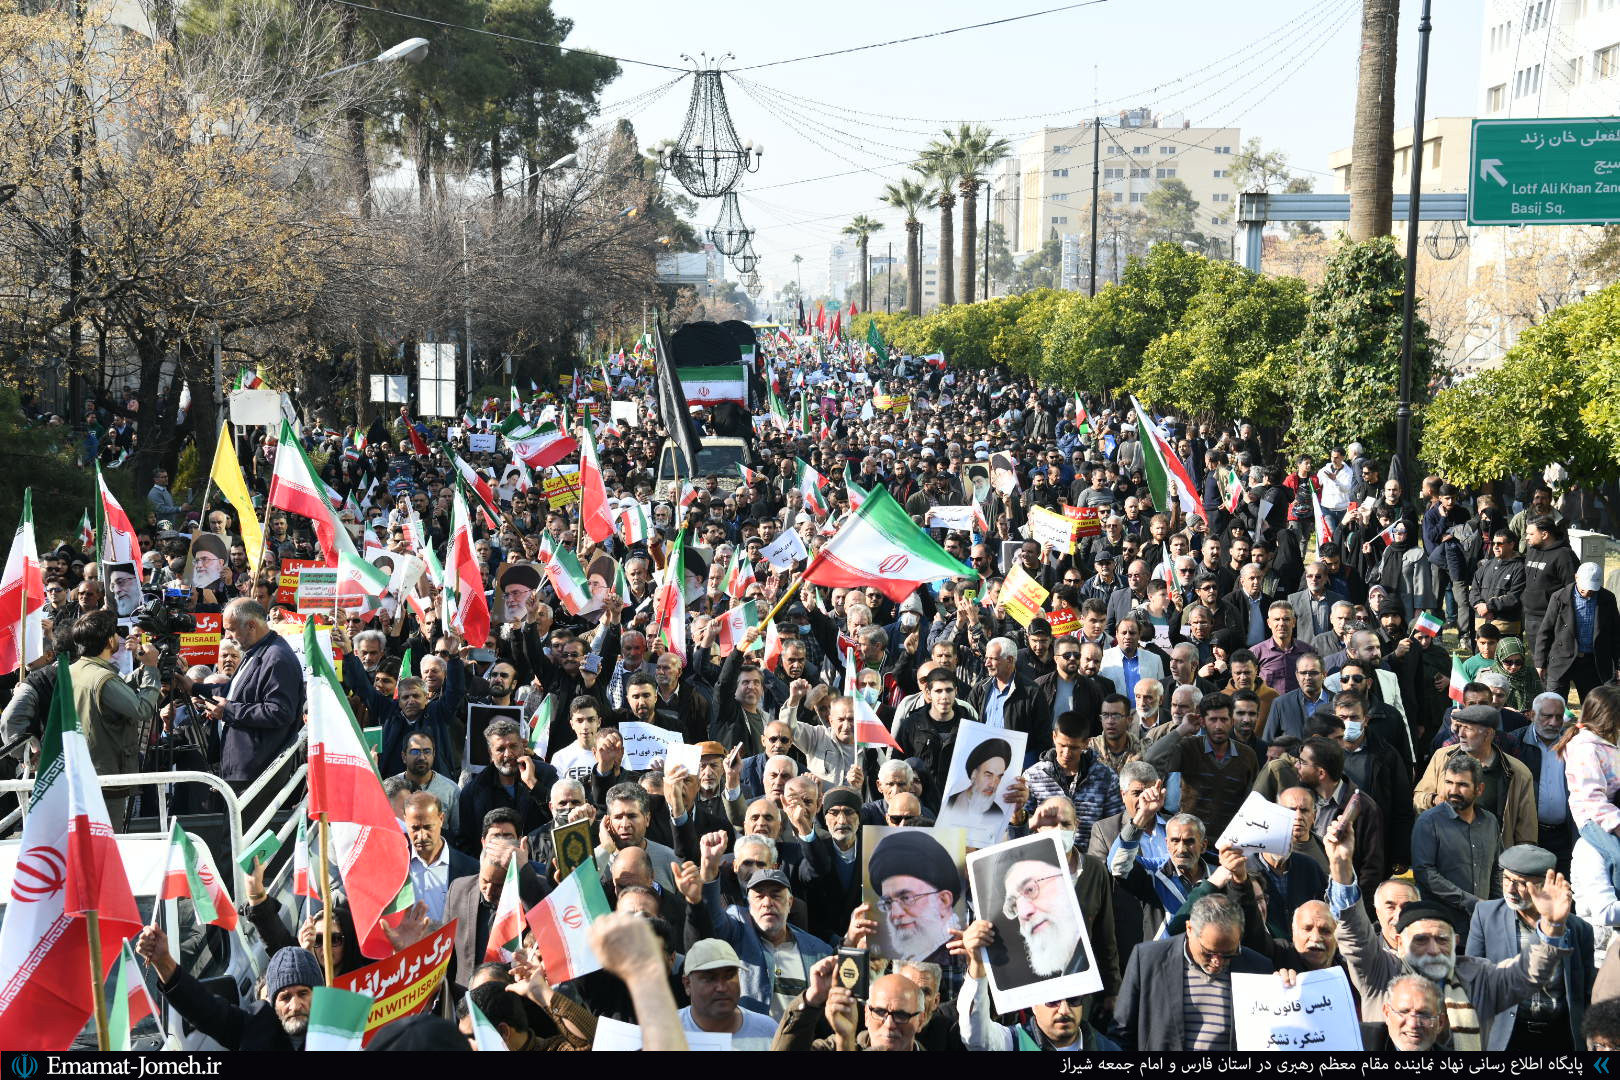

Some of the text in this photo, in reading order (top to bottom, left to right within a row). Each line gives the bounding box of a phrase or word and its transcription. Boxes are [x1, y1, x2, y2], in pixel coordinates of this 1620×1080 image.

[1520, 131, 1546, 150] زند
[1549, 130, 1577, 147] خان
[1512, 183, 1537, 195] Lotf
[1541, 182, 1558, 195] Ali
[1560, 182, 1592, 194] Khan
[1511, 202, 1566, 216] Basij Sq.
[423, 932, 452, 966] مرگ
[385, 990, 417, 1016] WITH
[1305, 995, 1333, 1014] پلیس
[1266, 1034, 1290, 1049] تشکر
